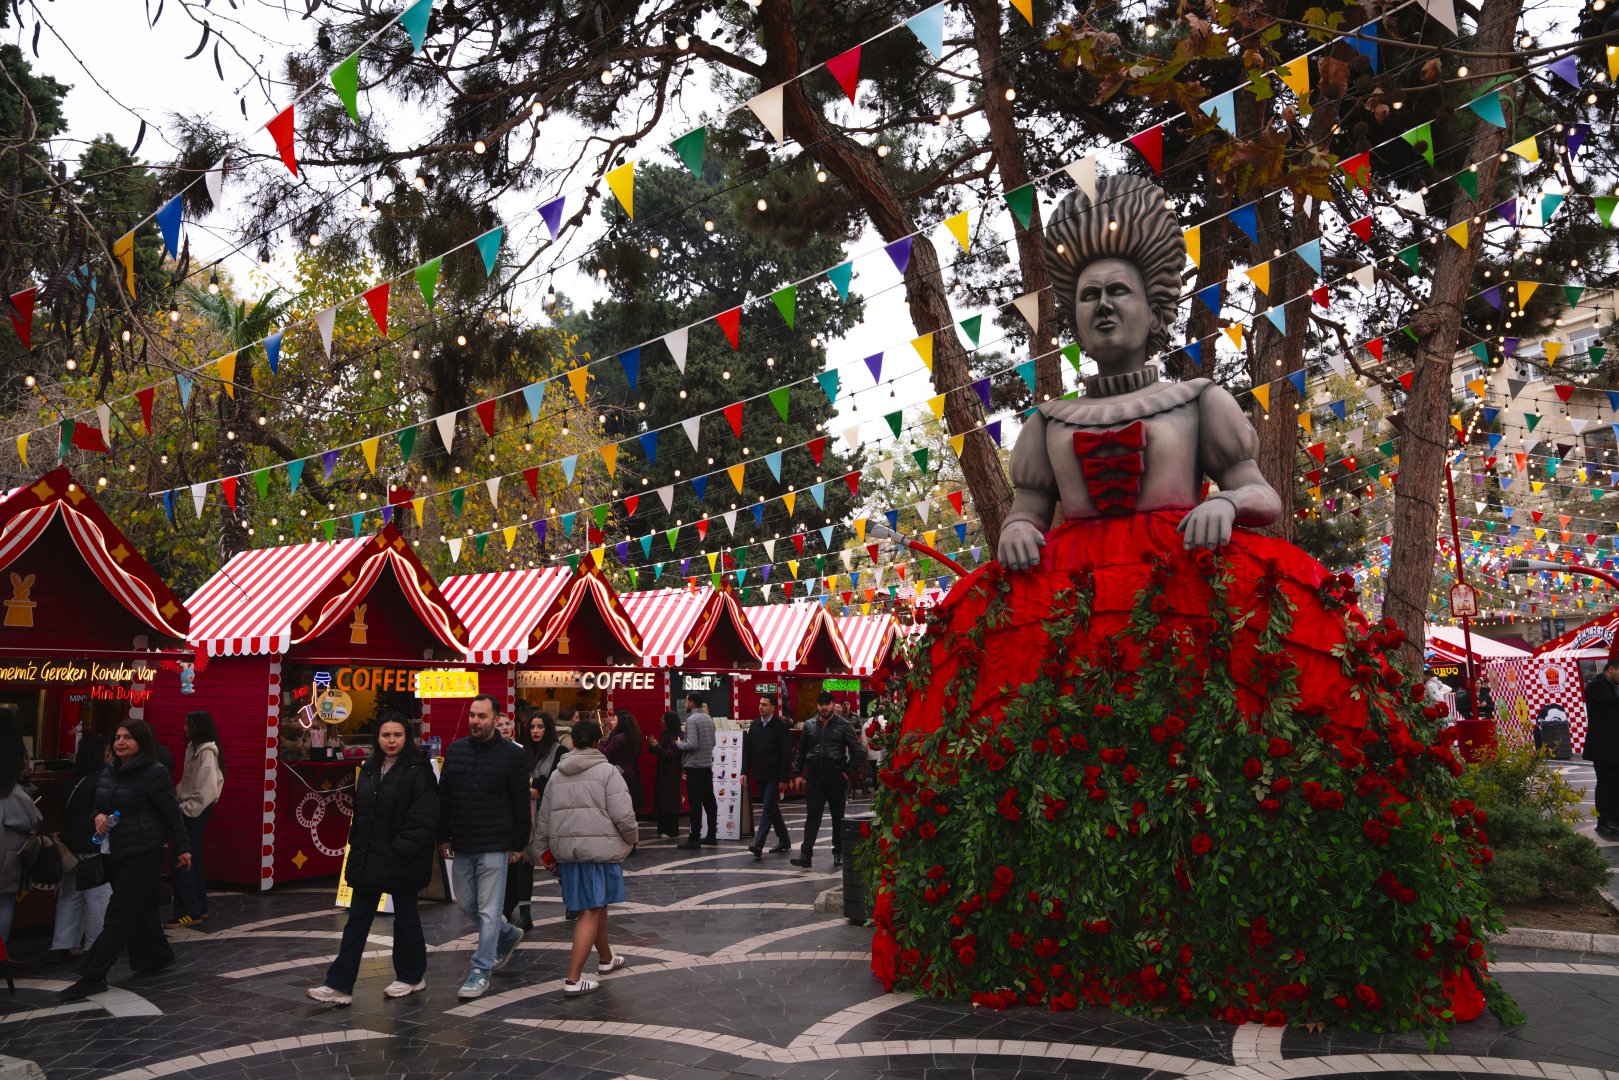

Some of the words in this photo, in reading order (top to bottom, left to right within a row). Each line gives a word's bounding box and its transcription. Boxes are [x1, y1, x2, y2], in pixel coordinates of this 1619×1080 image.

[41, 661, 87, 682] Gereken
[91, 662, 136, 681] Konular
[138, 666, 157, 681] Var
[337, 668, 418, 691] COFFEE
[582, 672, 655, 690] COFFEE
[91, 685, 114, 700] Mini
[117, 686, 153, 703] Burger
